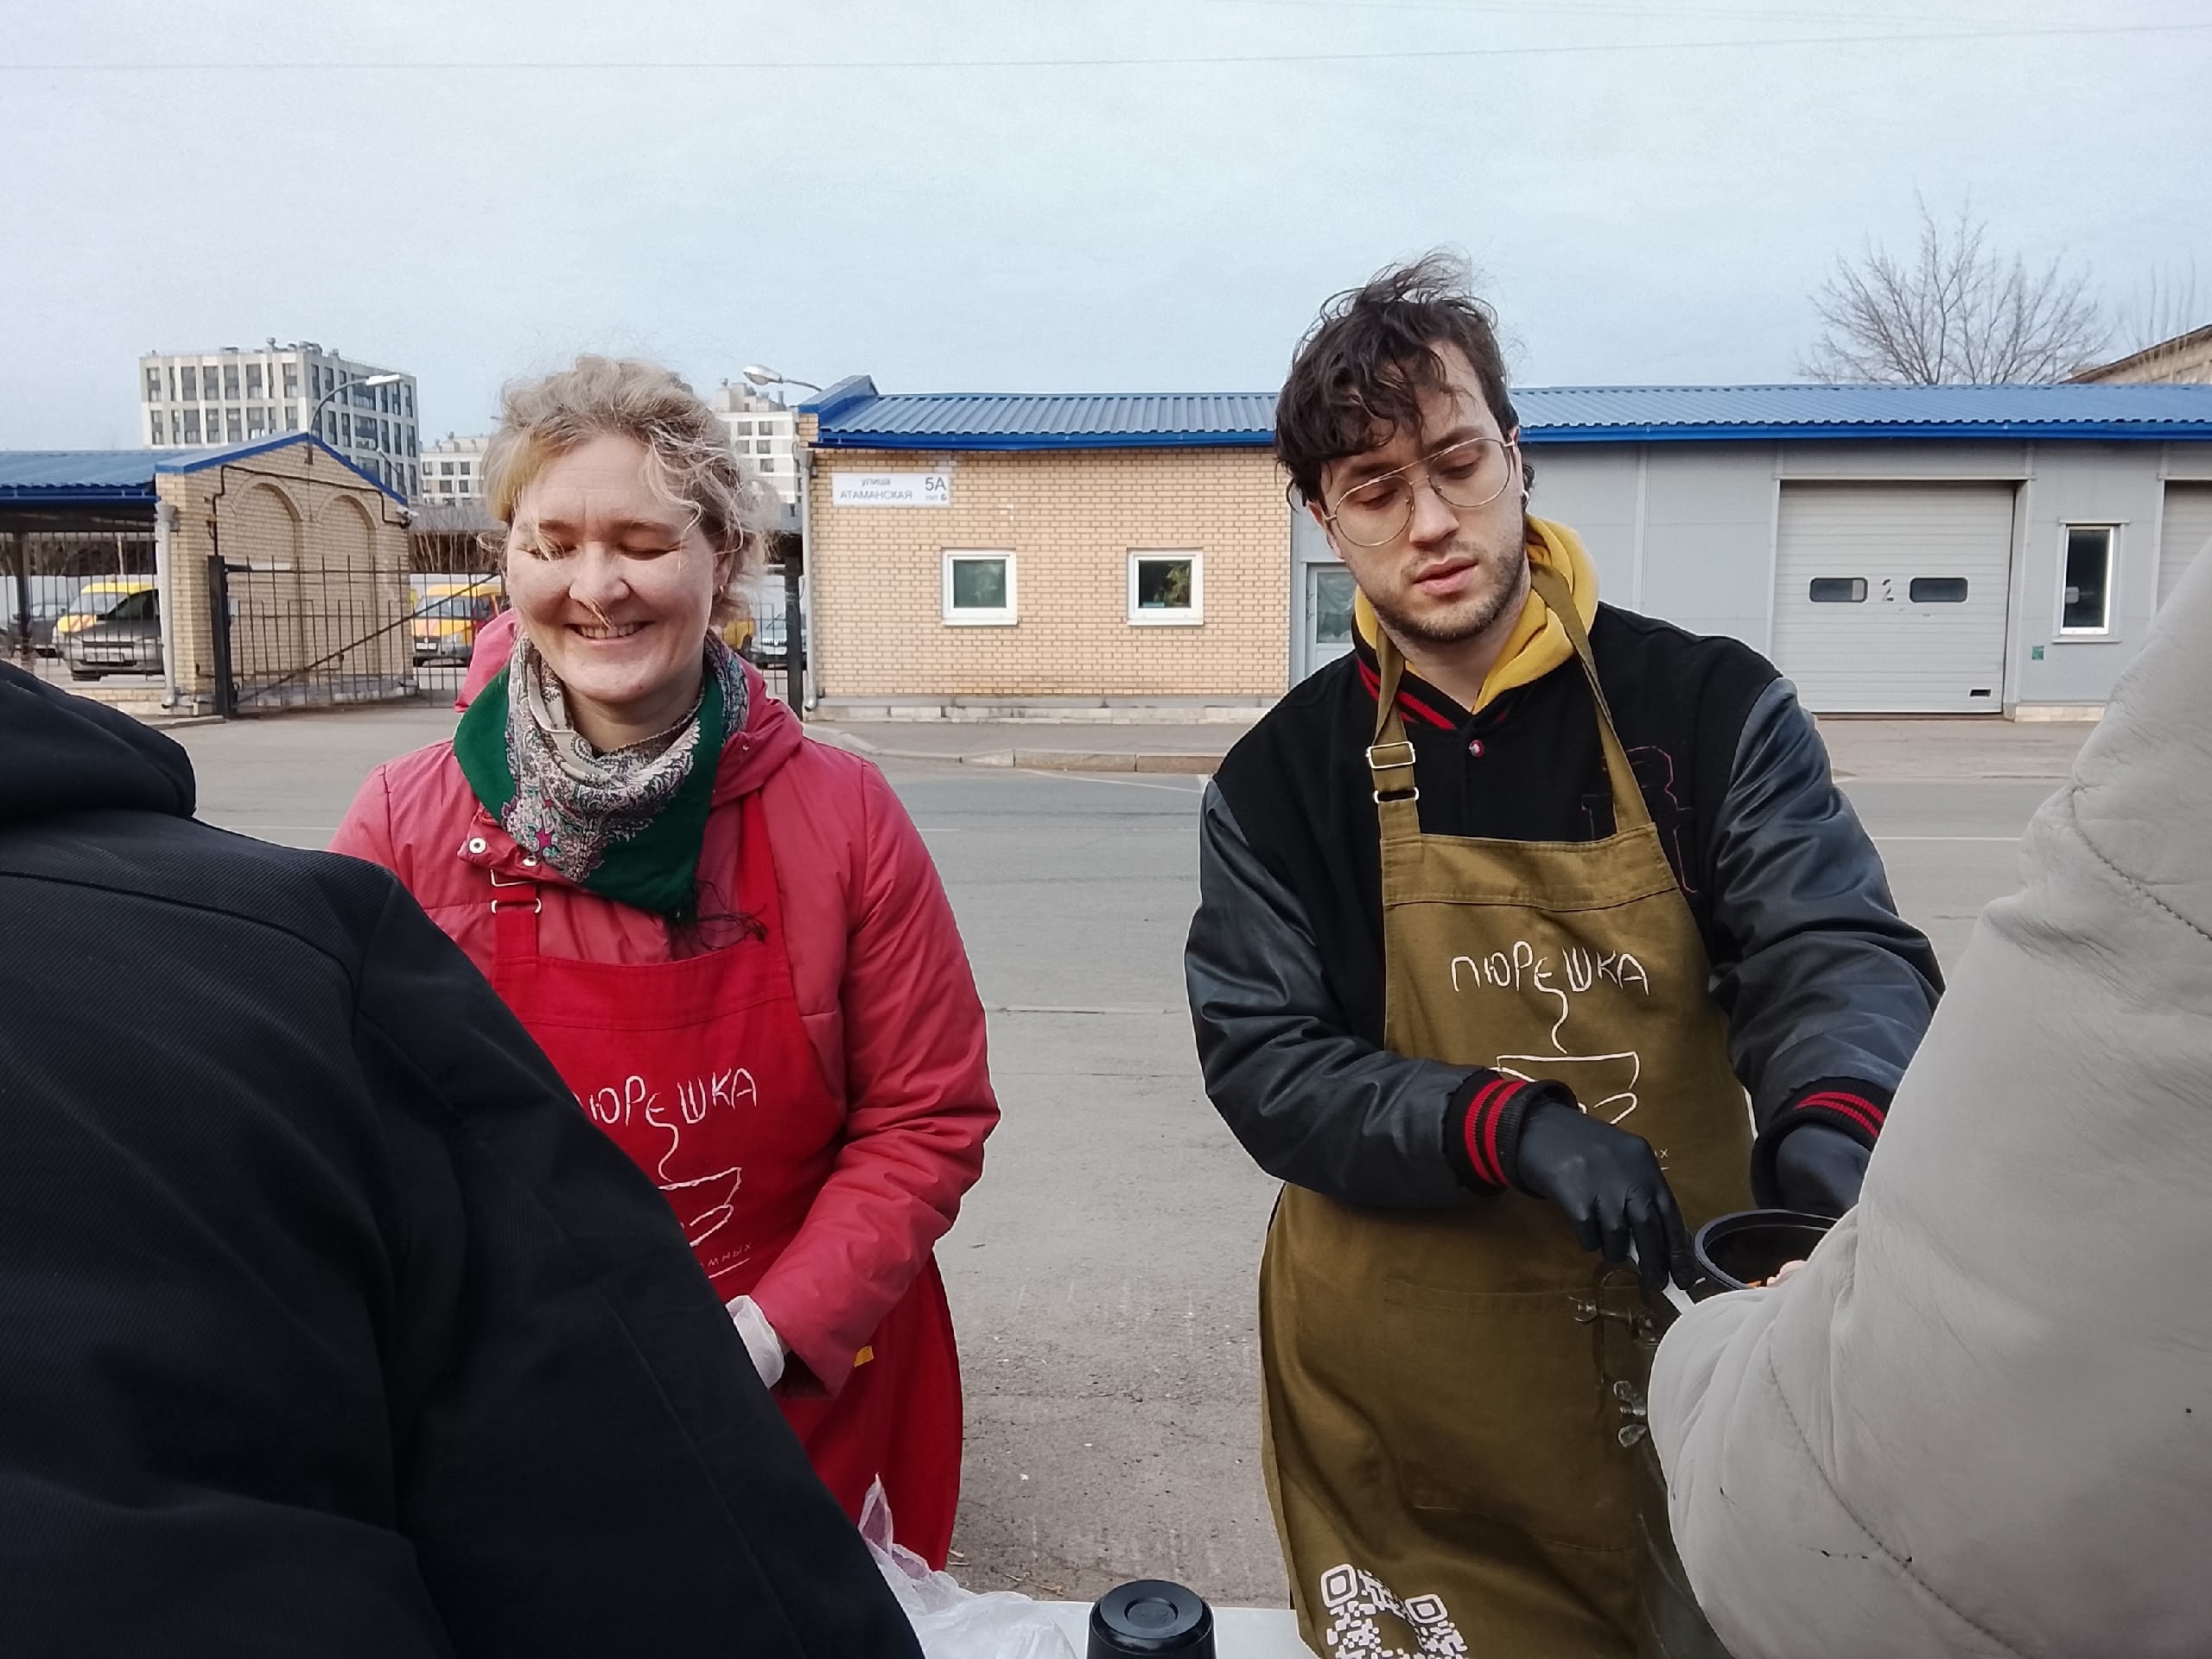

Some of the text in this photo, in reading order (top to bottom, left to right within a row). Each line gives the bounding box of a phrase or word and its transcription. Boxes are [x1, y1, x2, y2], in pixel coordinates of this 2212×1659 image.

[861, 477, 891, 486] улица
[925, 476, 947, 491] 5А
[840, 490, 912, 499] АТАМАНСКАЯ
[1880, 578, 1895, 602] 2
[1451, 940, 1649, 996] ПЮРЕШКА
[573, 1066, 757, 1128] ЮРЕШКА
